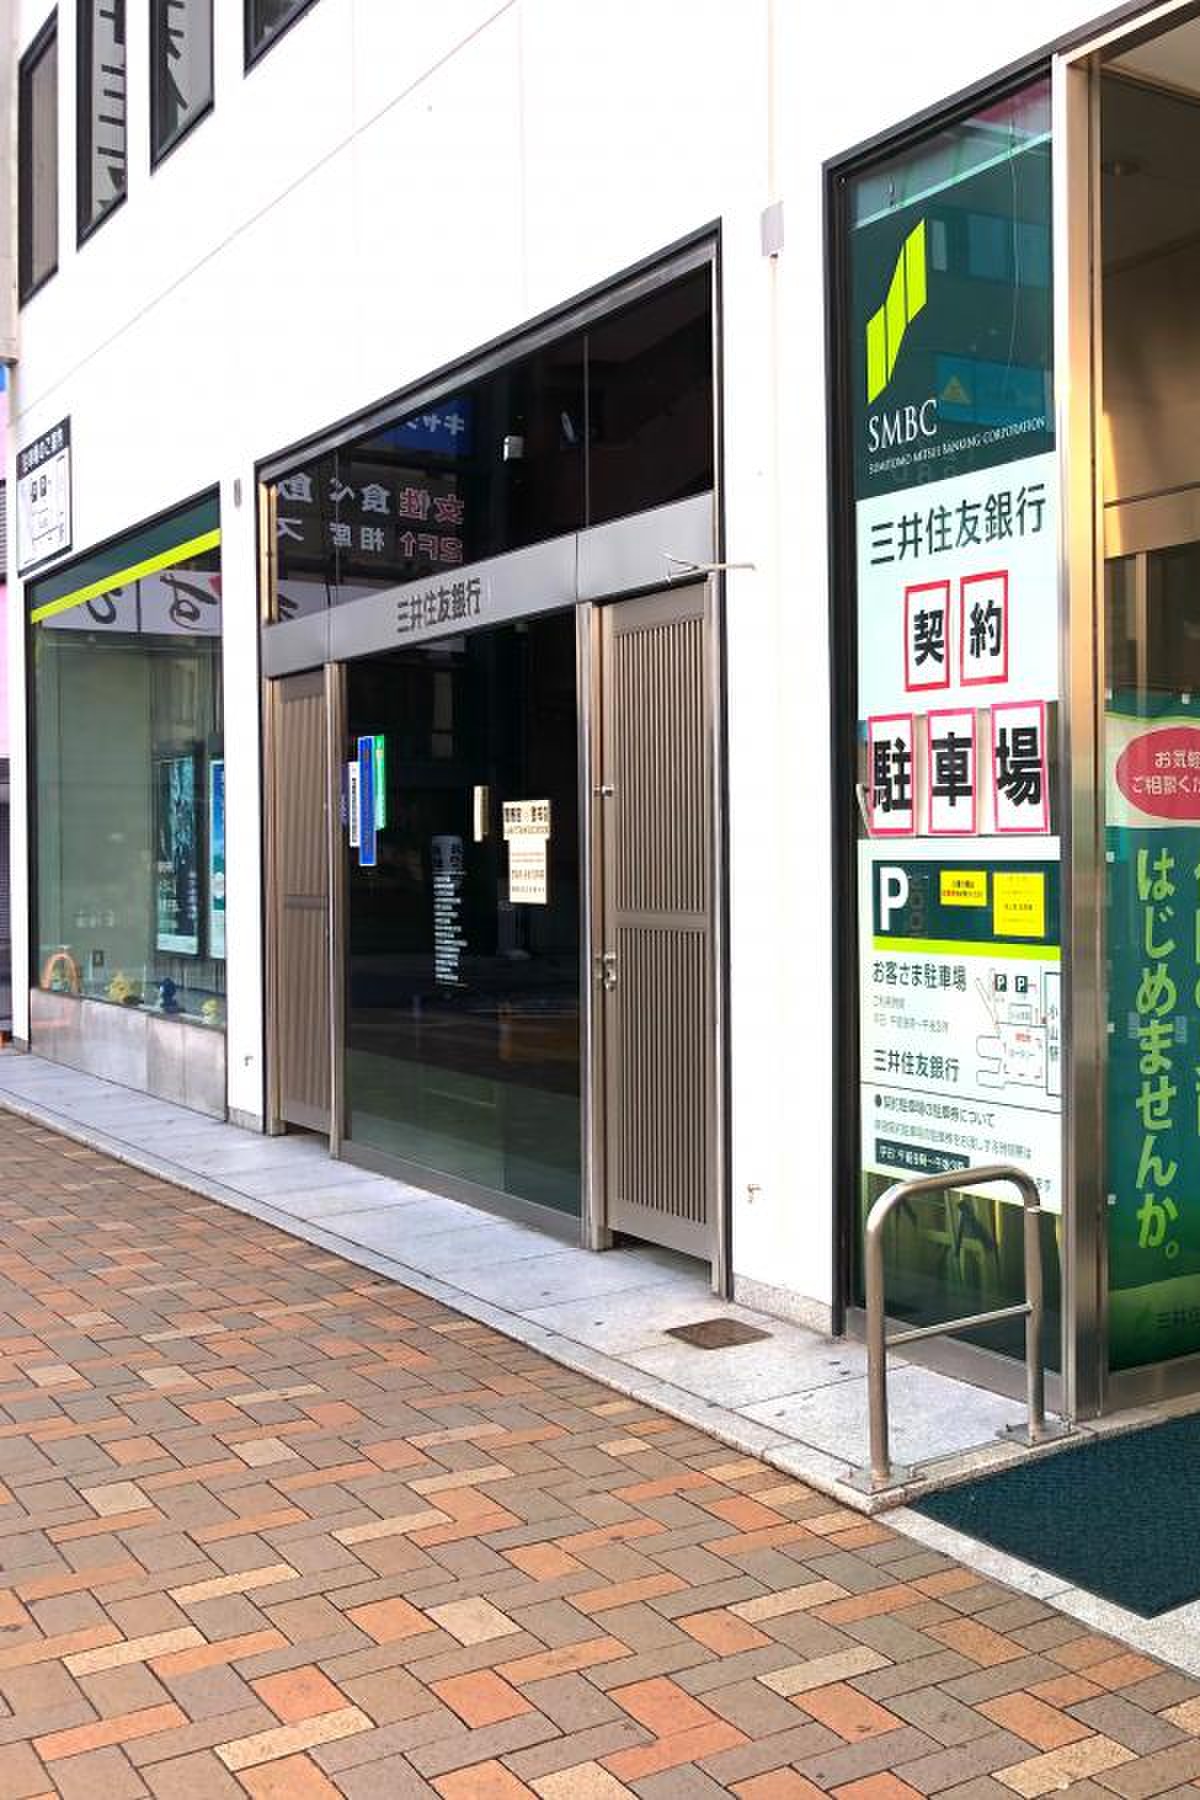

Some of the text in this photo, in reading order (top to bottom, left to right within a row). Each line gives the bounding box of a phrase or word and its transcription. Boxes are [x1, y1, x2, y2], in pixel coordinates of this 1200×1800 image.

[868, 399, 938, 452] SMBC
[870, 483, 1046, 565] 三井住友銀行
[397, 577, 481, 634] 三井住友銀行
[913, 600, 1002, 666] 契約
[873, 727, 1042, 813] 駐車場
[879, 866, 910, 931] P
[873, 960, 967, 992] お客さま駐車場
[873, 1049, 960, 1083] 三井住友銀行
[1135, 847, 1180, 1259] はじめませんか。
